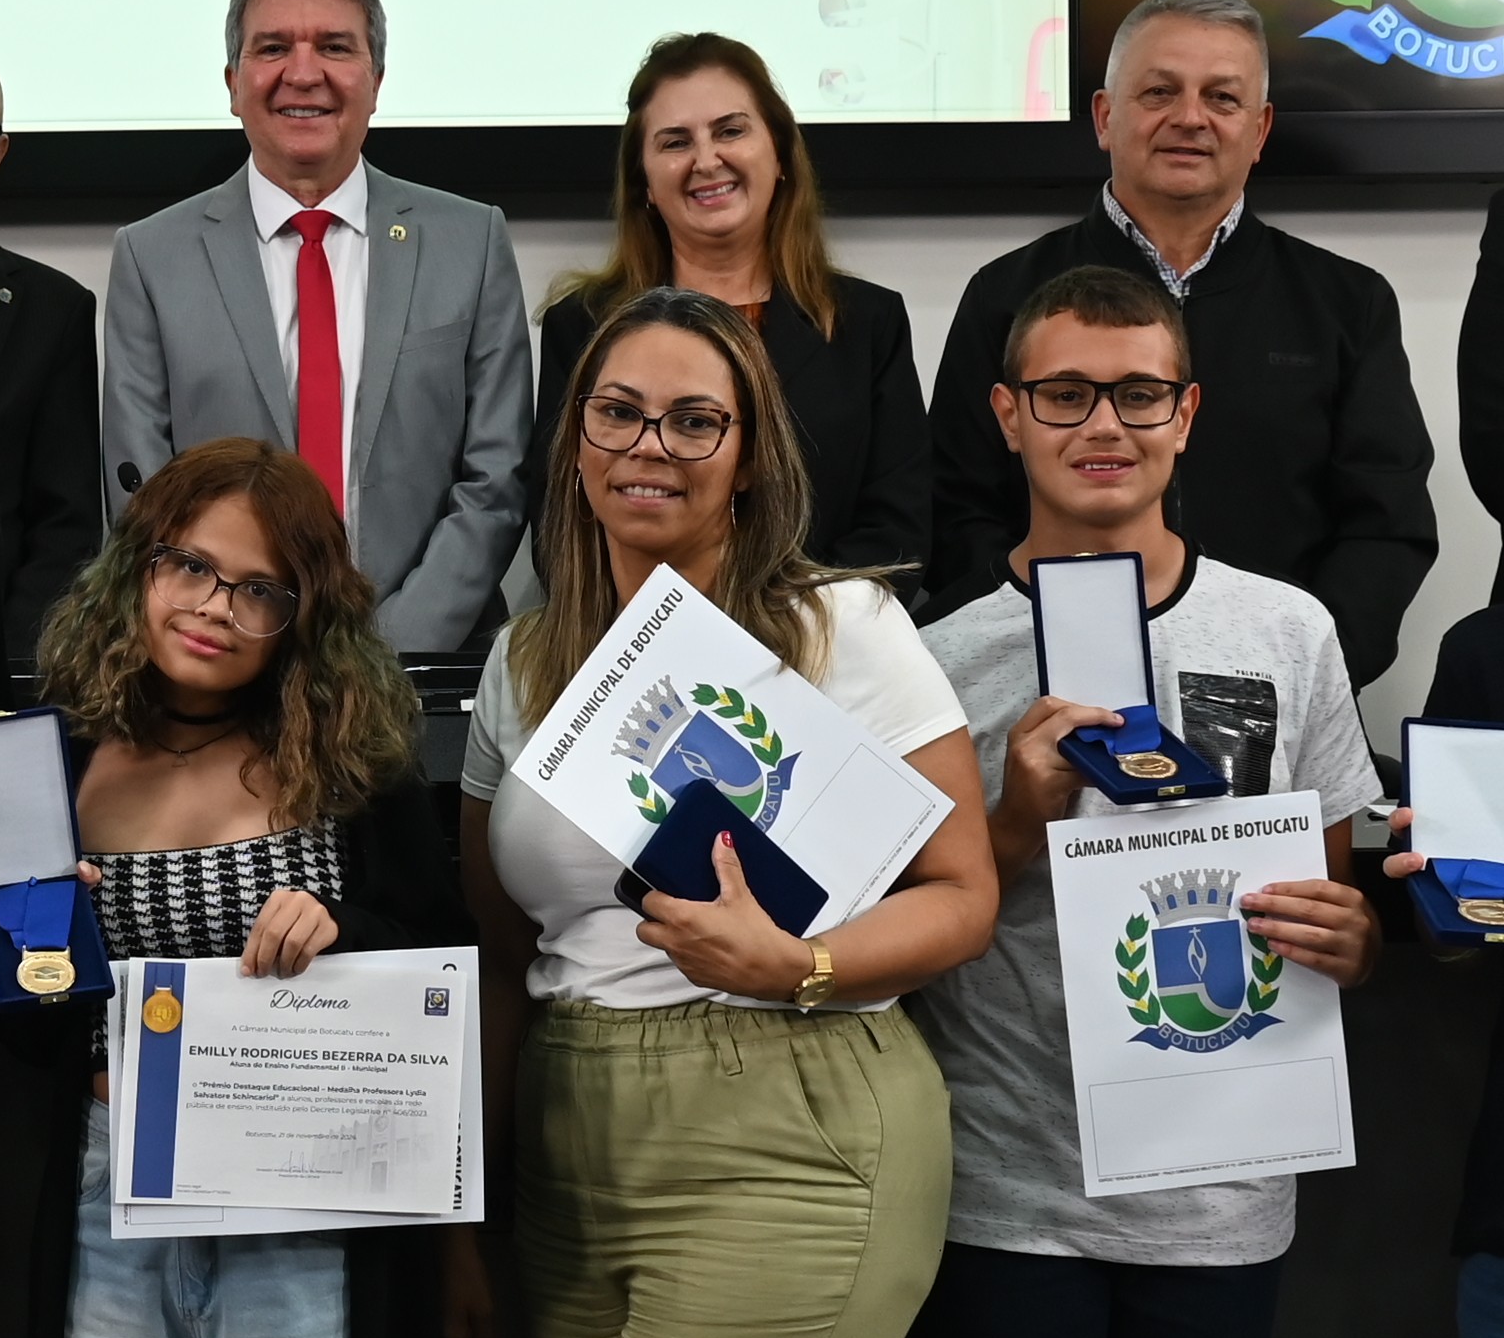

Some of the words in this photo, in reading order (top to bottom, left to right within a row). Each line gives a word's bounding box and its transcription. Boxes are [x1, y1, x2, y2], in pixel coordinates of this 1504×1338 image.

[539, 733, 577, 781] CÂMARA
[570, 669, 624, 735] MUNICIPAL
[617, 649, 637, 670] DE
[630, 588, 683, 653] BOTUCATU
[757, 775, 781, 833] UCATU
[1065, 838, 1124, 858] CÂMARA
[1128, 828, 1207, 851] MUNICIPAL
[1211, 825, 1229, 841] DE
[1234, 816, 1309, 838] BOTUCATU
[270, 989, 351, 1012] Diploma
[1158, 1015, 1250, 1051] BOTUCATU
[189, 1046, 237, 1057] EMILLY
[241, 1048, 318, 1060] RODRIGUES
[322, 1051, 383, 1062] BEZERRA
[388, 1053, 406, 1063] DA
[410, 1054, 448, 1065] SILVA
